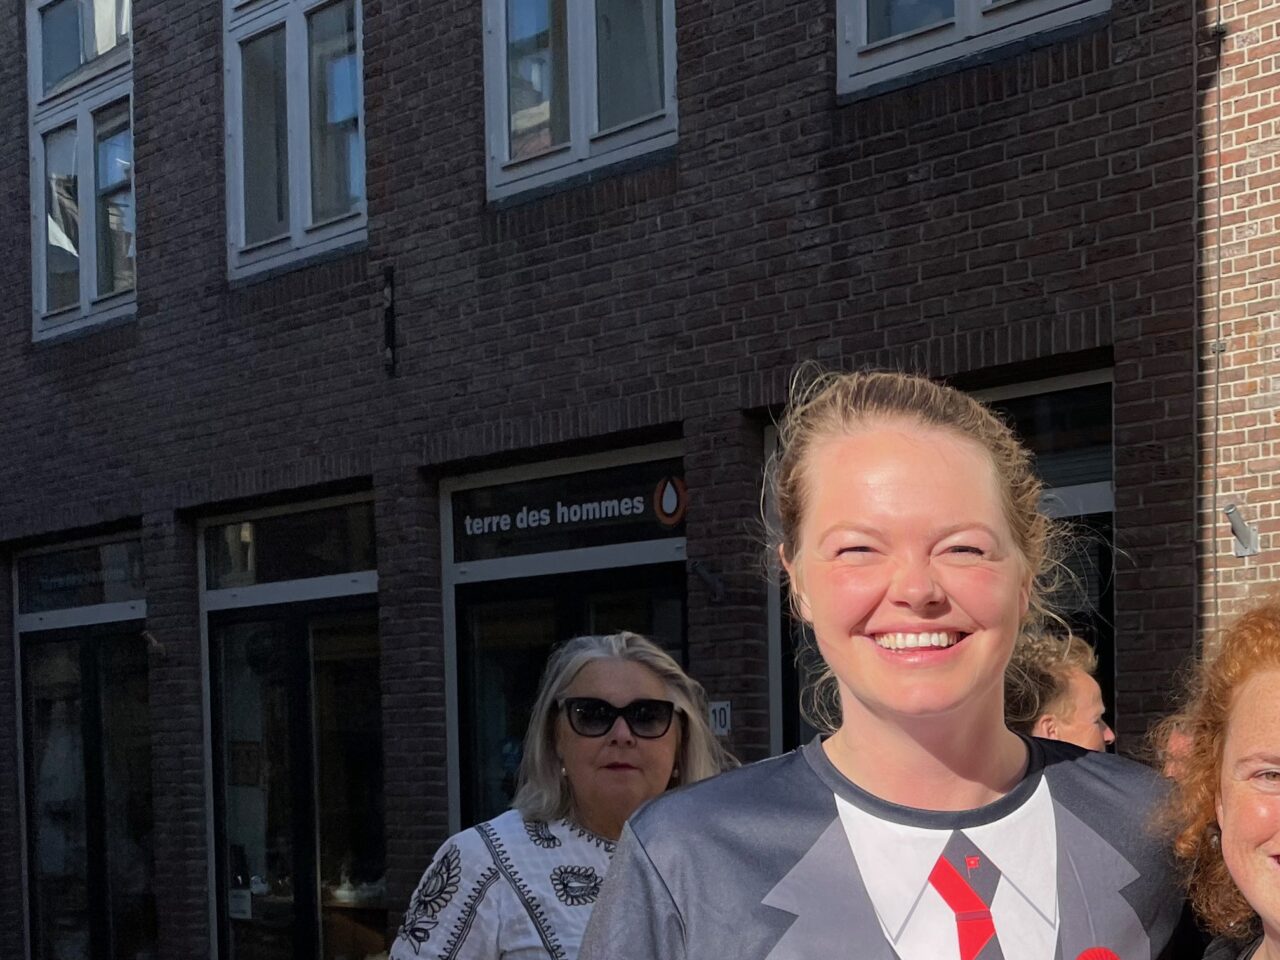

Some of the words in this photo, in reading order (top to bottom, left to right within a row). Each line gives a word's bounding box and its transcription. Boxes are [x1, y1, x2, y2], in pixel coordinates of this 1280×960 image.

[464, 515, 511, 536] terre
[516, 506, 551, 529] des
[556, 496, 645, 523] hommes
[711, 706, 727, 729] 10
